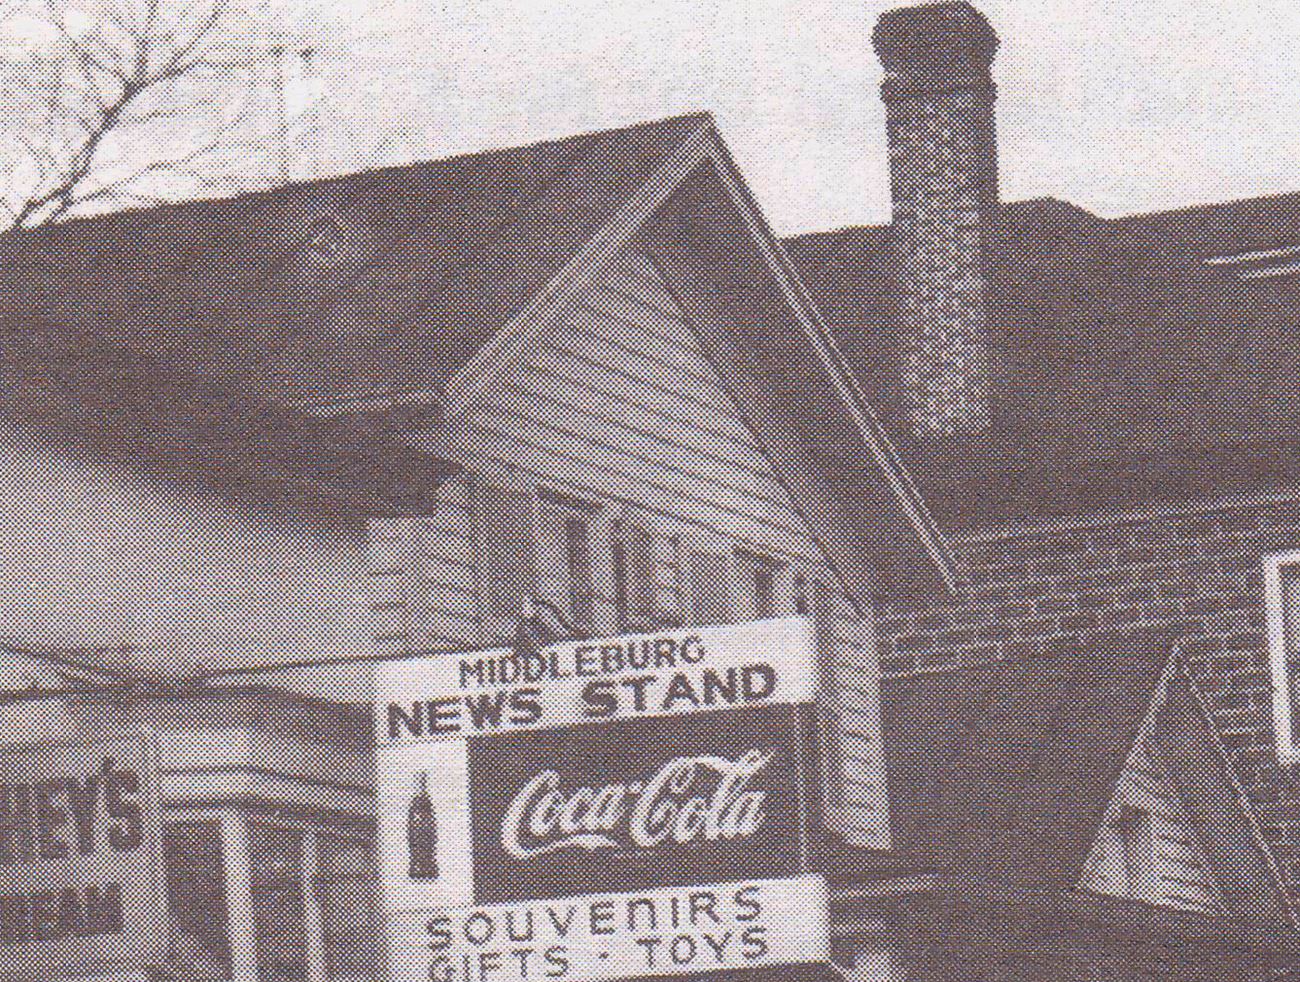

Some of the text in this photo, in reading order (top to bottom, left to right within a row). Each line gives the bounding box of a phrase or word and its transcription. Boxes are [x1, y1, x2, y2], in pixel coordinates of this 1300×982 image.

[460, 636, 705, 689] MIDDLEBURG
[387, 663, 778, 739] NEWS STAND
[501, 748, 775, 862] Coca-Cola
[427, 885, 764, 950] SOUVENIRS
[637, 927, 769, 970] TOYS
